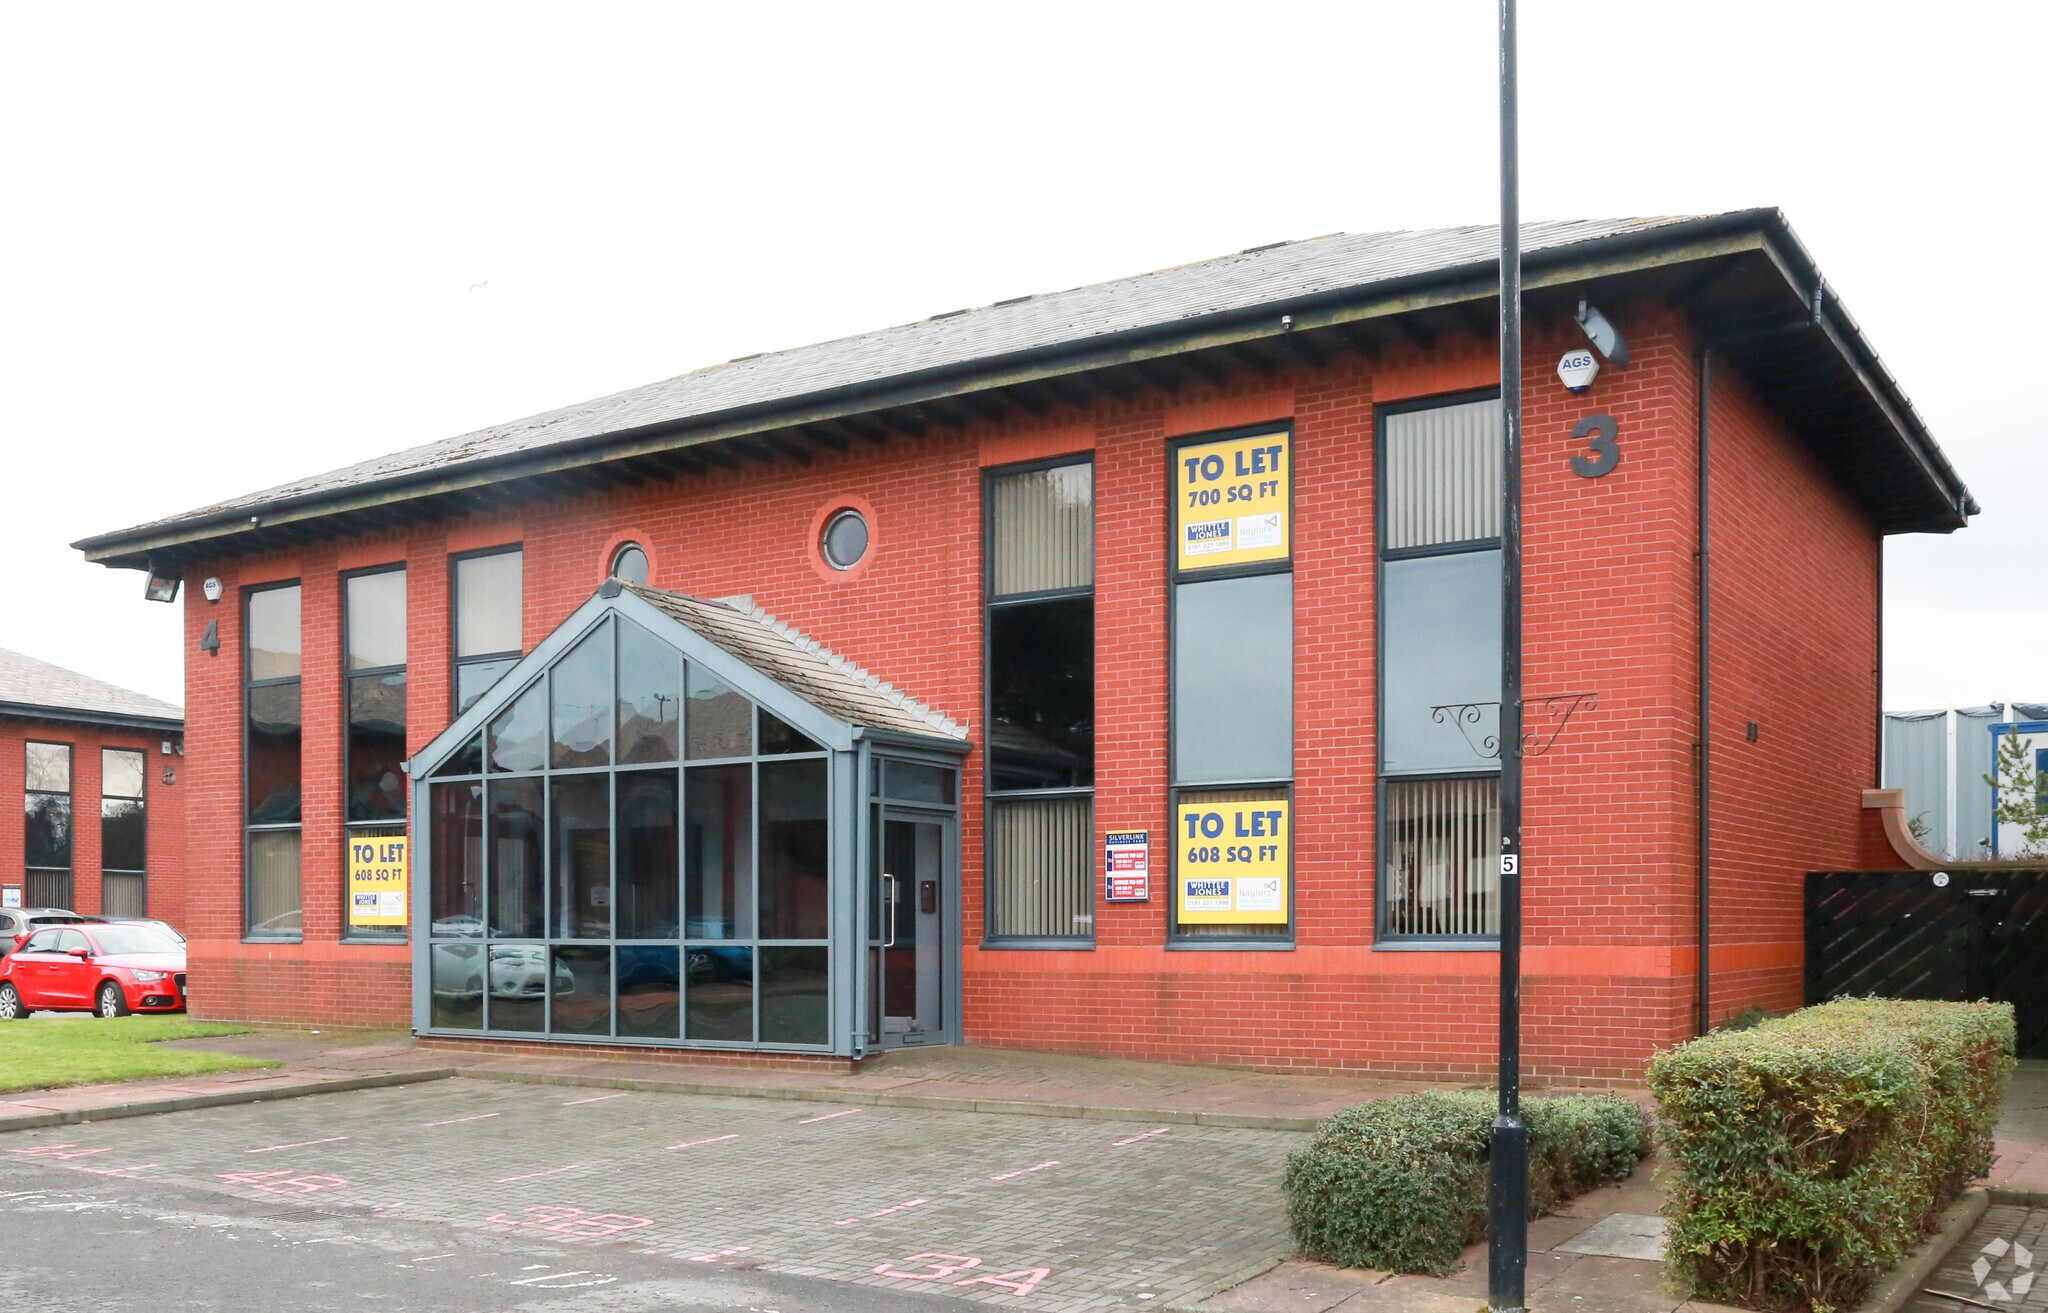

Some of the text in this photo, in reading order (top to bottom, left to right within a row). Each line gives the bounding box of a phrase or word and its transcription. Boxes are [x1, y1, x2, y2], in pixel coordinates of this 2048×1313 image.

[1562, 356, 1591, 370] AGS
[1570, 413, 1620, 479] 3
[1184, 444, 1283, 484] TO LET
[1188, 480, 1279, 508] 700 SQ FT
[1191, 522, 1226, 533] WHITTLE
[1195, 530, 1222, 540] JONES
[205, 581, 217, 589] AGS
[200, 619, 220, 657] 4
[1184, 810, 1283, 839] TO LET
[353, 843, 404, 863] TO LET
[1187, 845, 1278, 864] 608 SQ FT
[1503, 856, 1514, 872] 5
[355, 868, 402, 881] 608 SQ FT
[1190, 881, 1226, 889] WHITTLE
[1195, 888, 1222, 896] JONES
[215, 1170, 348, 1195] 4B
[486, 1205, 656, 1237] 3B
[873, 1252, 1051, 1297] 3A
